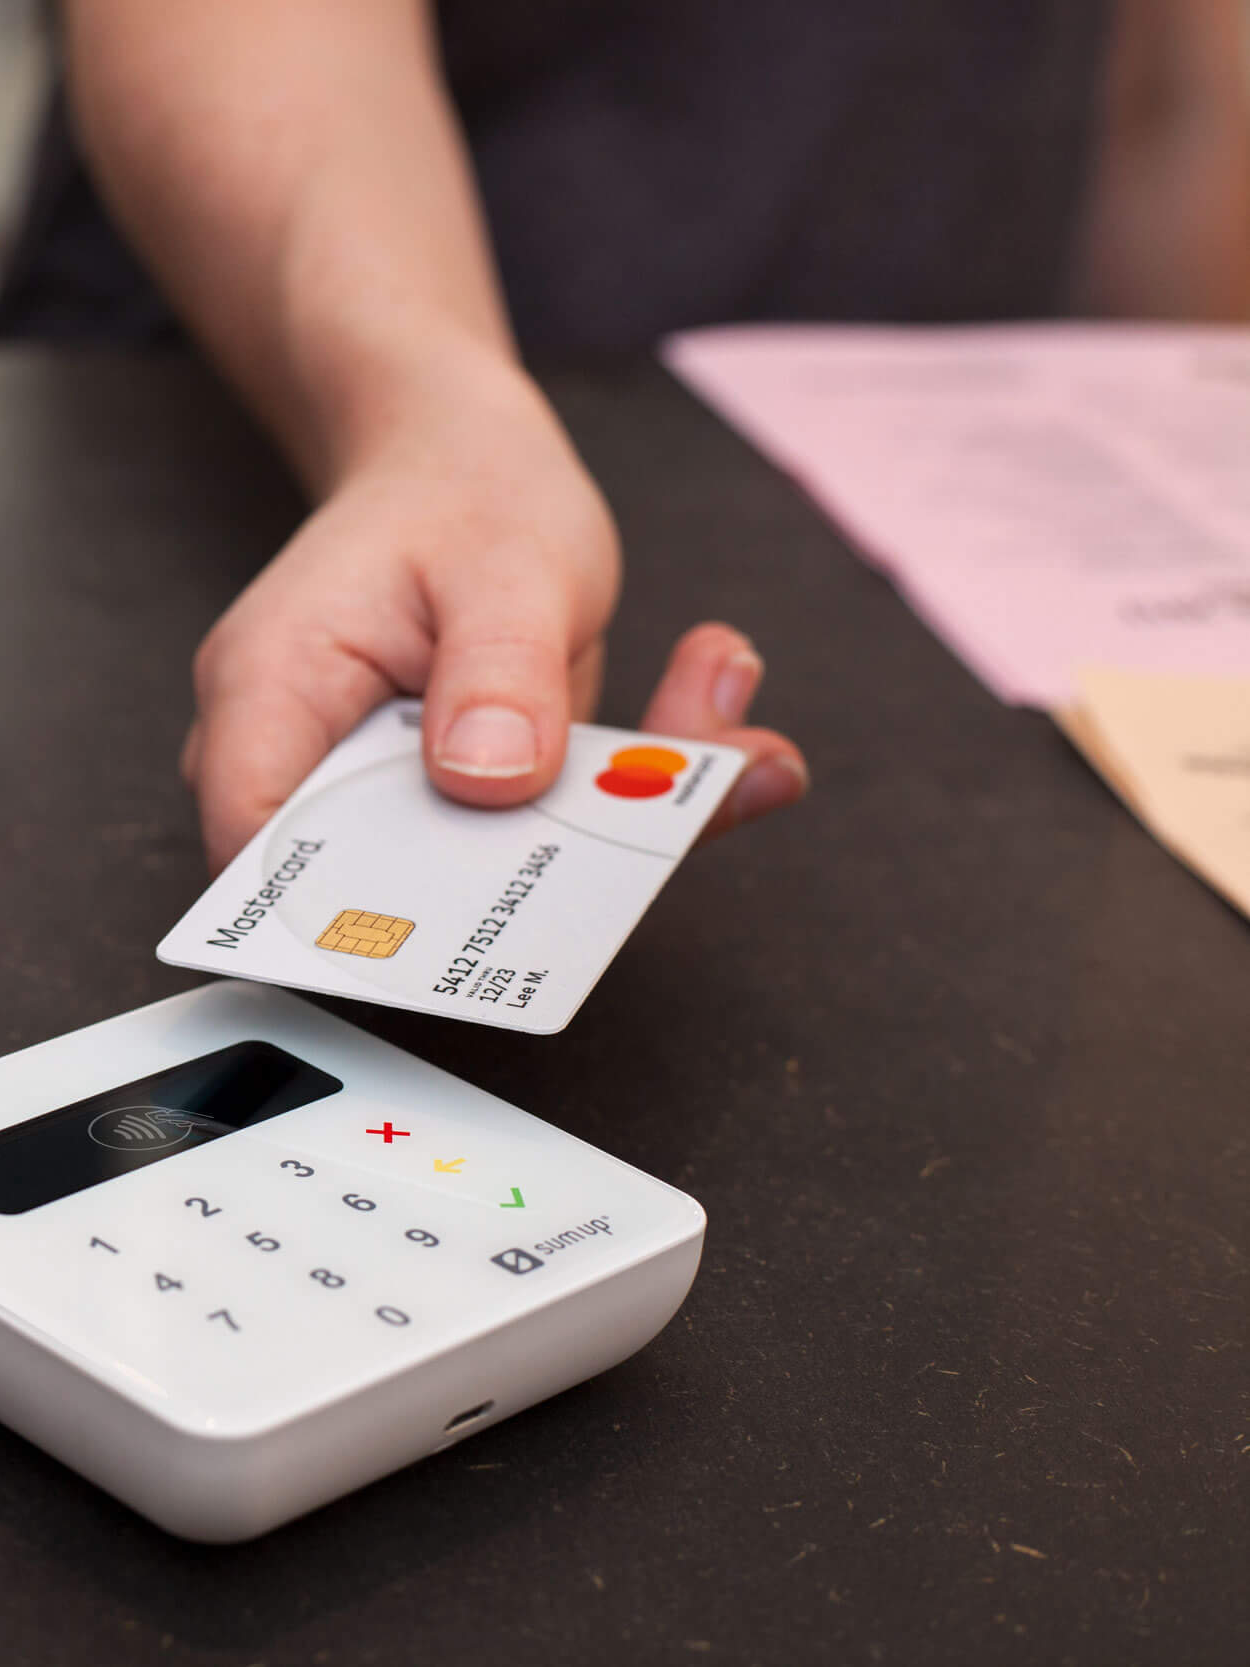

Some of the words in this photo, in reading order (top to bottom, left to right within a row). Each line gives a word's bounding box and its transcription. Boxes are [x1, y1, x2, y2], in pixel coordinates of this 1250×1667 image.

[206, 839, 326, 949] Mastercard
[433, 957, 479, 995] 5412
[462, 918, 507, 954] 7512
[491, 880, 535, 916] 3412
[479, 968, 516, 1003] 12/23
[506, 986, 536, 1008] Lee
[523, 970, 549, 984] M.
[90, 1237, 120, 1254] 1
[184, 1197, 222, 1217] 2
[280, 1160, 314, 1178] 3
[154, 1272, 184, 1292] 4
[245, 1231, 281, 1252] 5
[342, 1193, 377, 1212] 6
[207, 1309, 240, 1332] 7
[309, 1268, 345, 1289] 8
[404, 1229, 440, 1248] 9
[375, 1306, 411, 1328] 0
